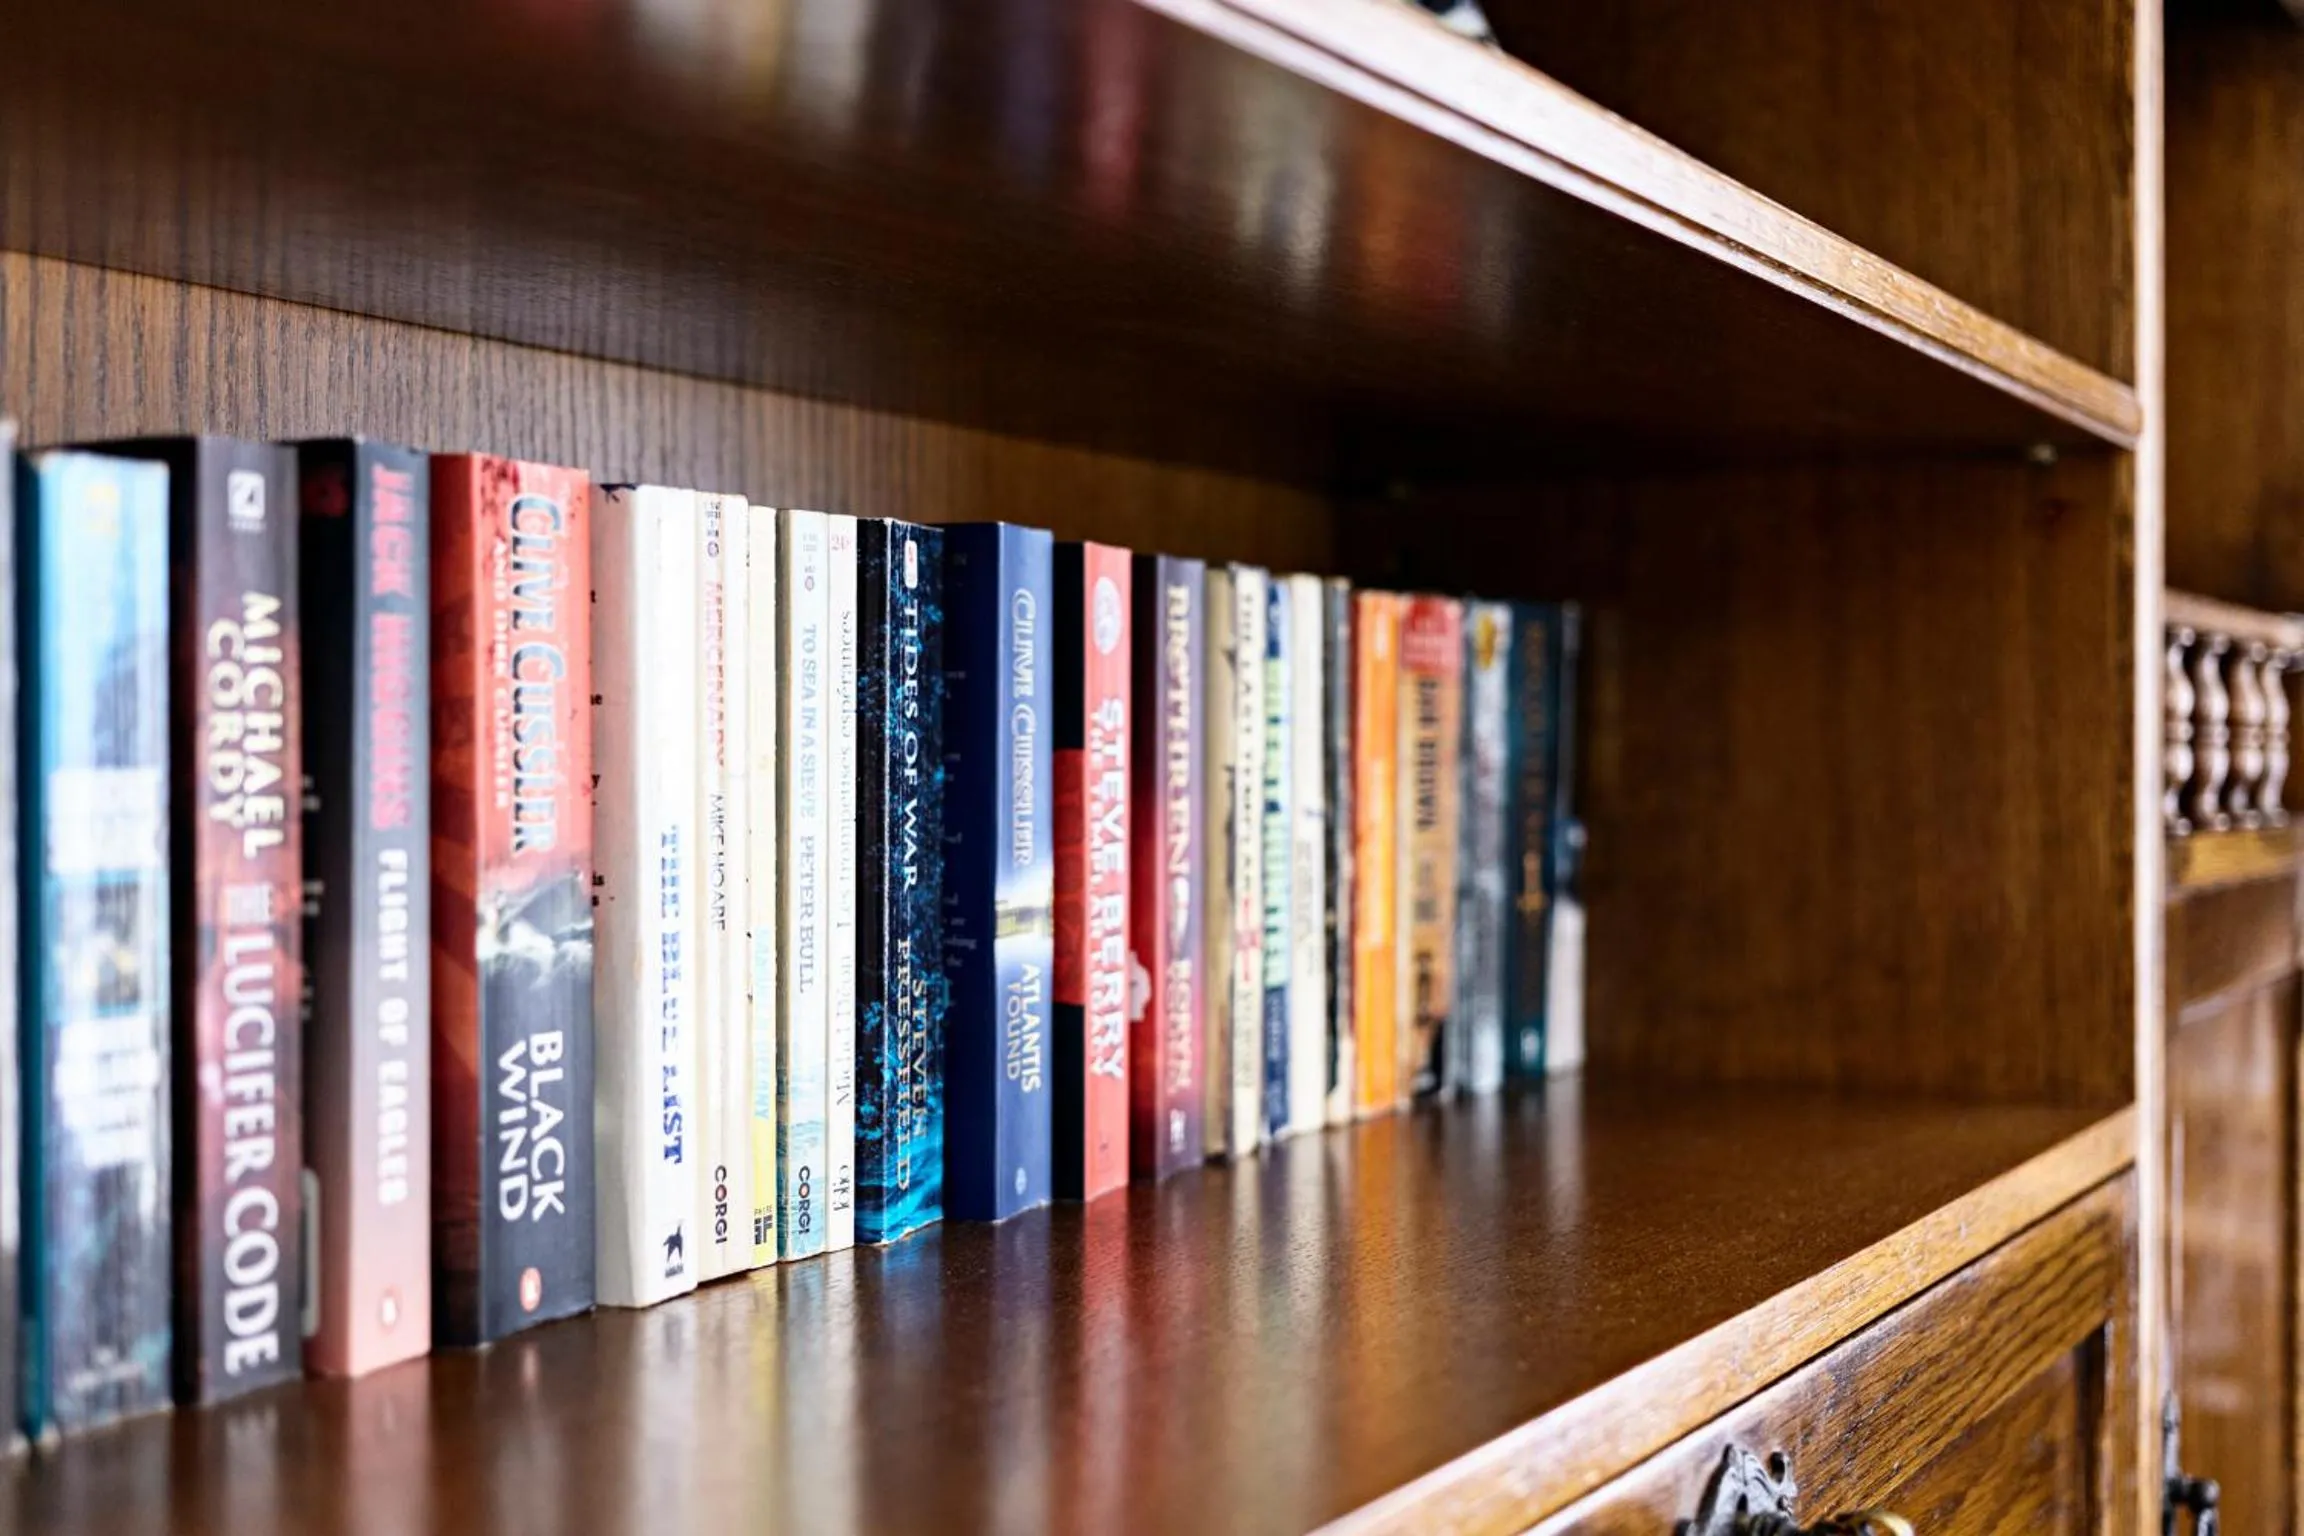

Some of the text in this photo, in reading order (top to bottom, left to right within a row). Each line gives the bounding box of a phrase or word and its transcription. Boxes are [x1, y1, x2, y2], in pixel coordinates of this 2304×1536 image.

[207, 617, 246, 829] CORDY
[243, 592, 284, 860] MICHAEL
[371, 462, 414, 830] JACK HIGGINS
[511, 494, 566, 854] CLIVE CUSSLER
[801, 624, 818, 819] TO SEA IN A SIEVE
[1011, 589, 1038, 866] CLIVE CUSSLER
[705, 581, 726, 932] MERCENARY MIKE HOARE
[903, 600, 918, 892] TIDES OF WAR
[661, 824, 682, 918] THE
[799, 835, 816, 994] PETER BULL
[1100, 697, 1126, 1079] STEVE BERRY
[222, 933, 275, 1184] LUCIFER
[379, 848, 408, 1204] FLIGHT OF EAGLES
[663, 1065, 683, 1165] LIST
[898, 937, 911, 1189] PRESSFIELD
[912, 978, 928, 1138] STEVEN
[1006, 982, 1021, 1082] FOUND
[1021, 962, 1042, 1093] ATLANTIS
[498, 1039, 528, 1222] WIND
[529, 1029, 565, 1222] BLACK
[715, 1164, 728, 1245] CORGI
[798, 1164, 812, 1235] CORGI
[224, 1185, 279, 1377] CODE
